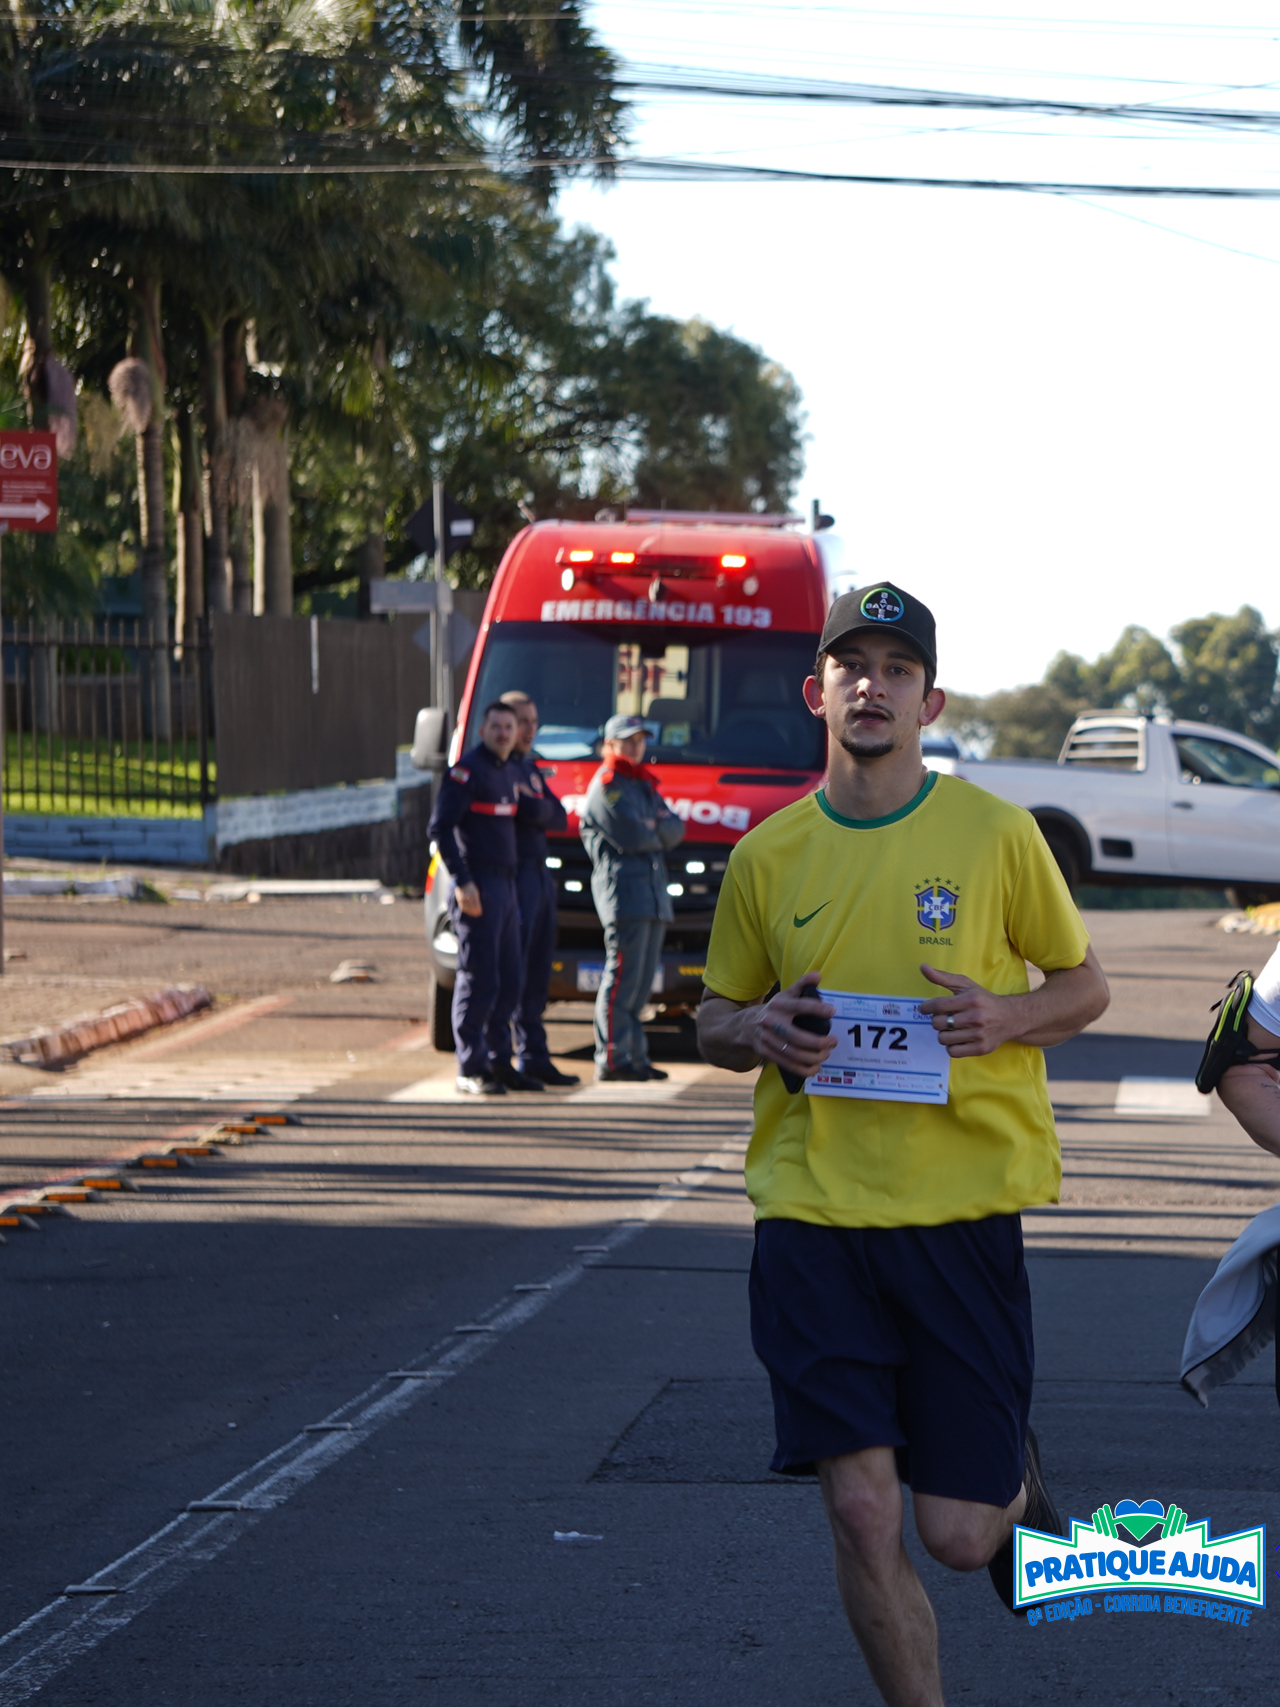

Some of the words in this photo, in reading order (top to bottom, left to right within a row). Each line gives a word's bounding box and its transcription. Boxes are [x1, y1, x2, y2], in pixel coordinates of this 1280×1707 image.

[0, 442, 52, 470] eva
[541, 598, 715, 623] EMERGÊNCIA
[720, 605, 772, 628] 193
[865, 602, 900, 613] BAYER
[919, 936, 954, 946] BRASIL
[848, 1024, 908, 1051] 172
